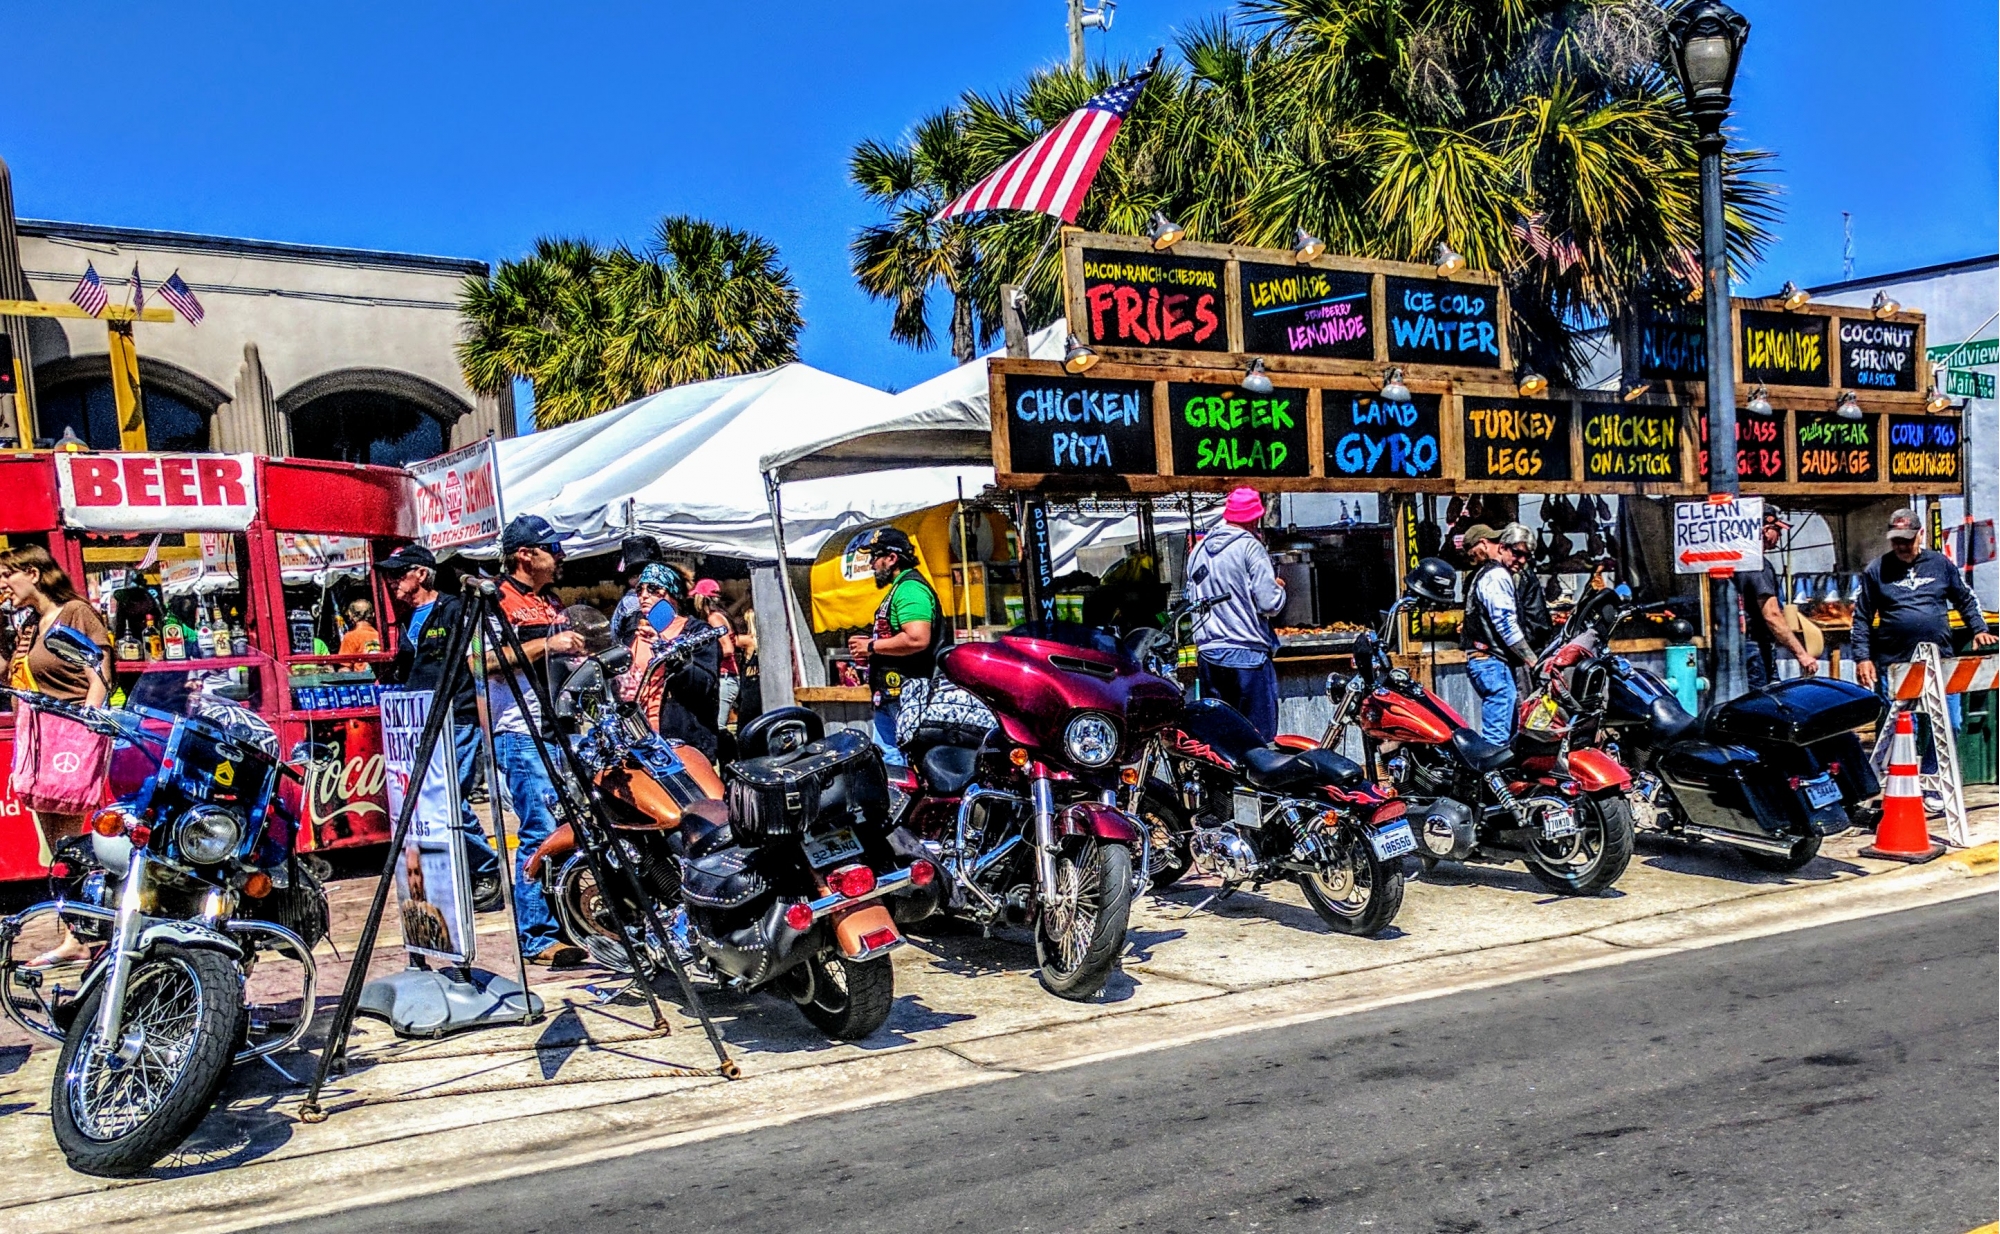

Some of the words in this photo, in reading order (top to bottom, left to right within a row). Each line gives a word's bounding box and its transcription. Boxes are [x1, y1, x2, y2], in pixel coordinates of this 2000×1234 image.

[1250, 274, 1331, 308] LEMONADE
[1439, 295, 1485, 317] COLD
[1287, 314, 1367, 352] LEMONADE
[1392, 313, 1499, 358] WATER
[1840, 323, 1913, 348] COCONUT
[1746, 326, 1822, 373] LEMONADE
[1857, 371, 1868, 385] ON
[1869, 373, 1875, 385] A
[1947, 372, 1976, 396] Main
[1184, 396, 1295, 431] GREEK
[1352, 399, 1418, 427] LAMB
[1468, 408, 1557, 441] TURKEY
[1823, 423, 1869, 445] STEAK
[1891, 423, 1924, 447] CORN
[1926, 423, 1956, 447] OGS
[1196, 437, 1288, 470] SALAD
[1335, 432, 1438, 477] GYRO
[1487, 445, 1543, 476] LEGS
[1590, 450, 1612, 475] ON
[1614, 453, 1625, 474] A
[1698, 448, 1782, 477] BGERS
[1801, 449, 1871, 475] SAUSAGE
[70, 457, 247, 507] BEER
[1676, 501, 1740, 520] CLEAN
[1677, 518, 1762, 546] RESTROOM
[1033, 508, 1052, 587] BOTTLED
[387, 732, 420, 762] RING
